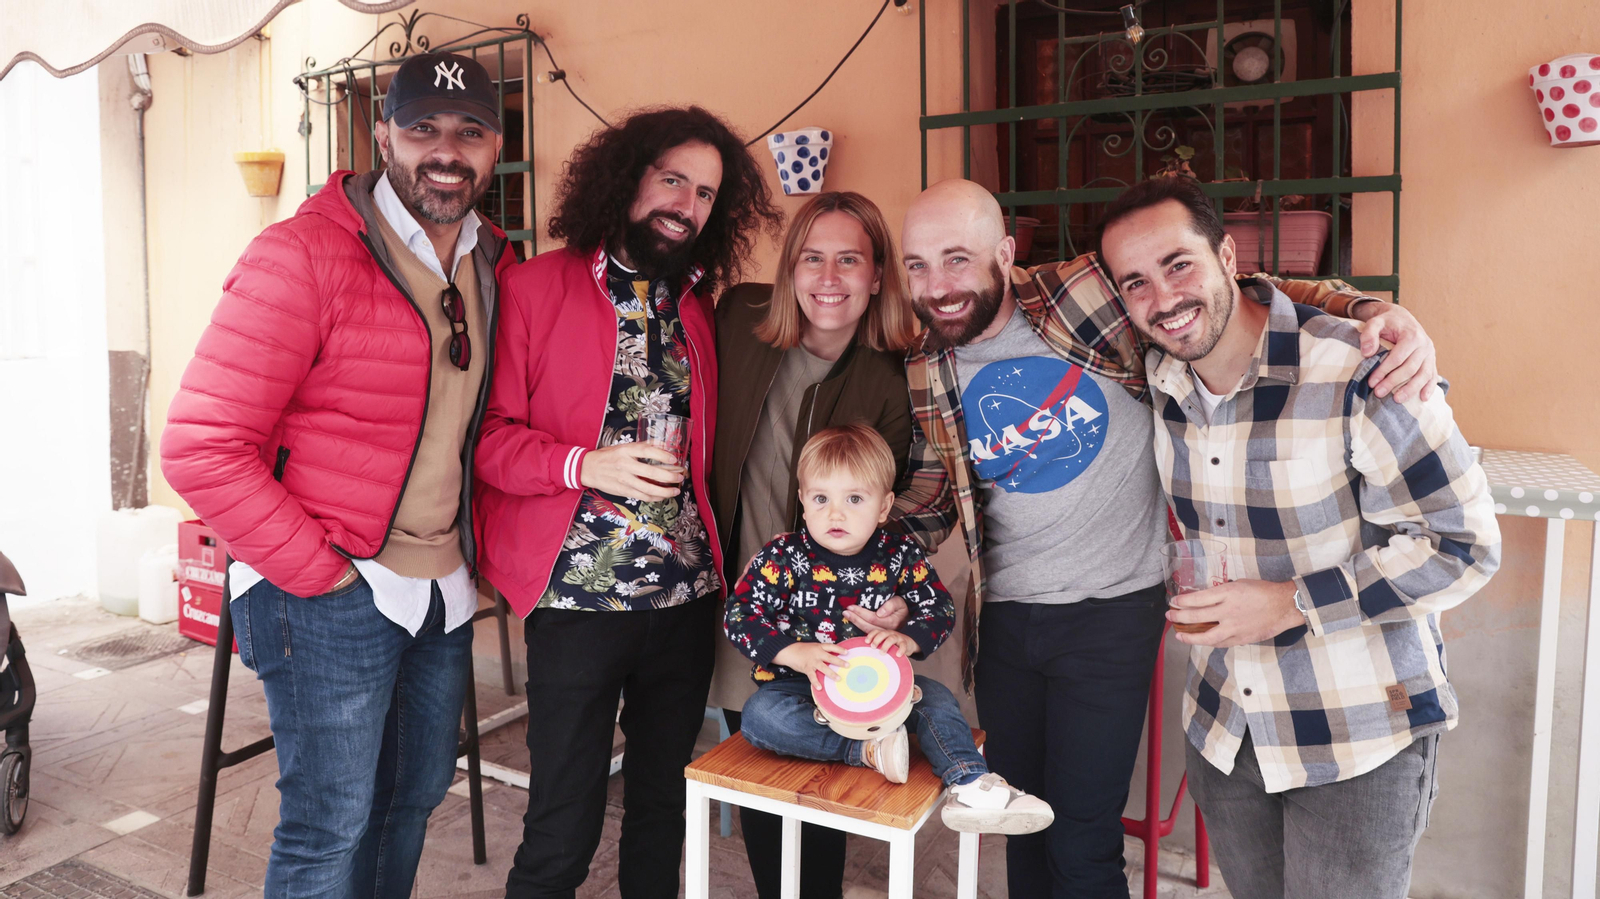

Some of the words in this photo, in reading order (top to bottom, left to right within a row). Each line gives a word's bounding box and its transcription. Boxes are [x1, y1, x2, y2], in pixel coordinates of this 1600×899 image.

[433, 60, 466, 90] NY
[968, 395, 1102, 464] NASA
[185, 565, 225, 587] CRUZCAMP
[183, 603, 220, 627] Cruzcam
